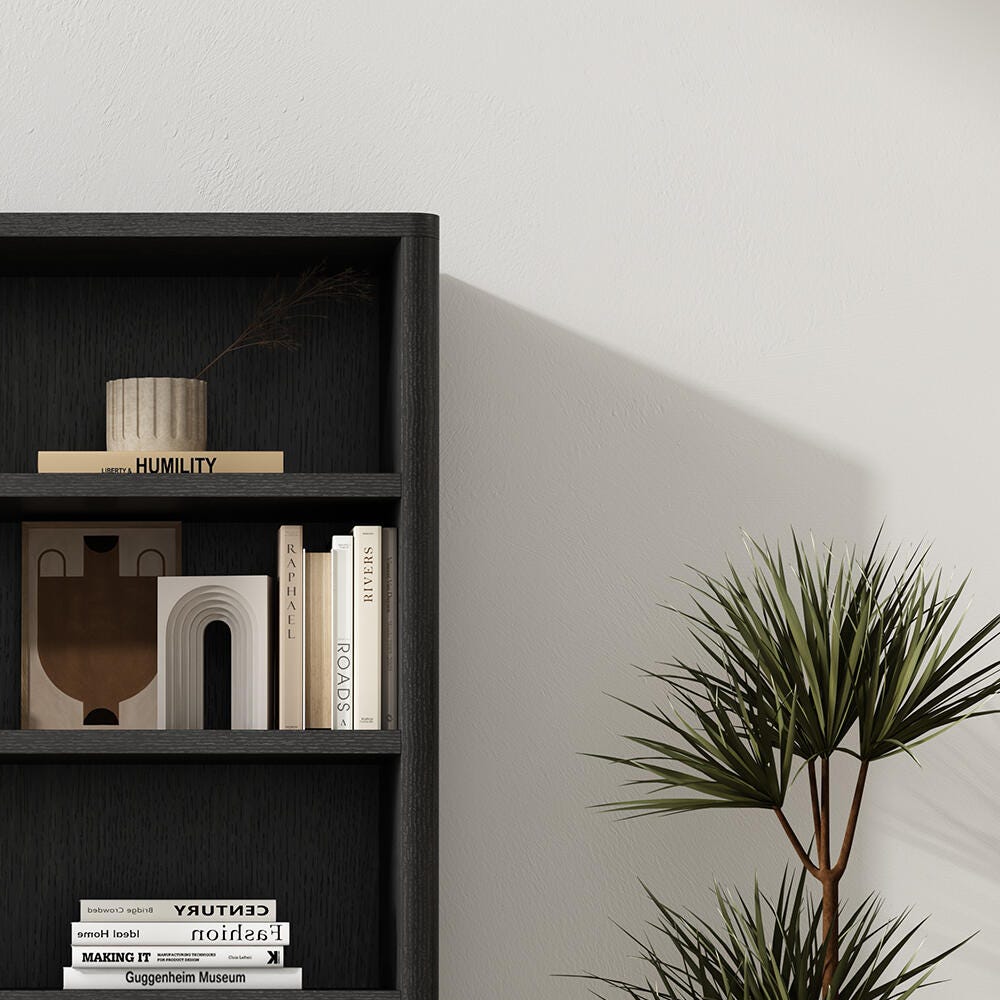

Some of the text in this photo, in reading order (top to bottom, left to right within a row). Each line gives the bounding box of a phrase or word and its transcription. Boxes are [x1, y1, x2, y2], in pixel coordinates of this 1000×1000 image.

[135, 457, 217, 474] HUMILITY
[286, 543, 297, 640] RAPHAEL
[363, 546, 374, 603] RIVERS
[336, 643, 351, 712] ROADS
[81, 952, 151, 963] MAKING IT
[125, 970, 246, 986] Guggenheim Museum
